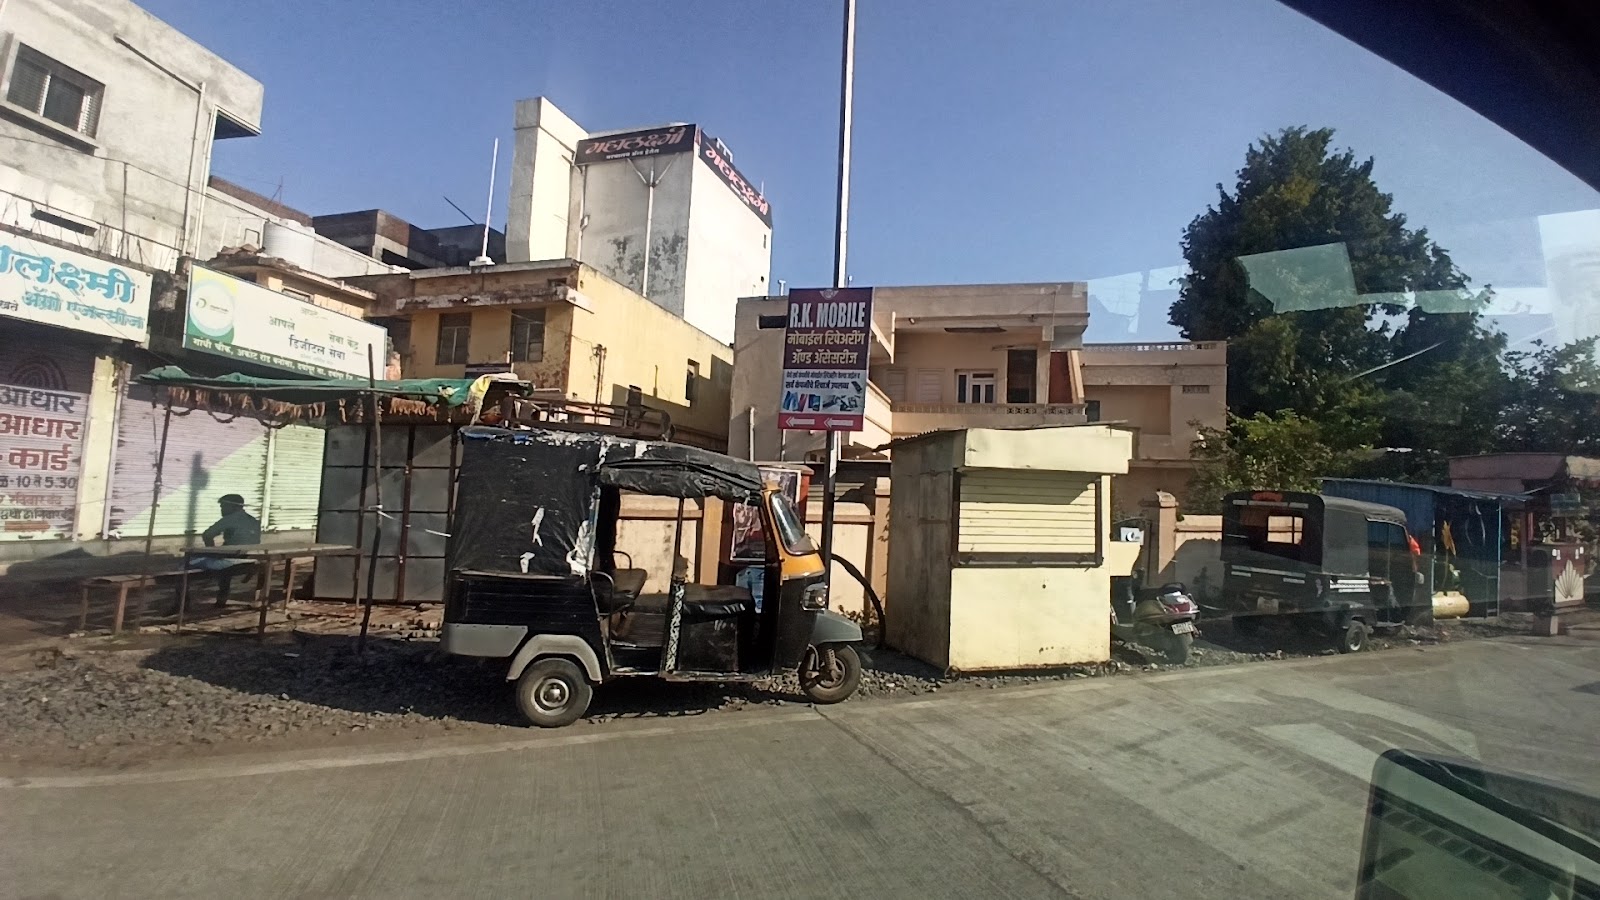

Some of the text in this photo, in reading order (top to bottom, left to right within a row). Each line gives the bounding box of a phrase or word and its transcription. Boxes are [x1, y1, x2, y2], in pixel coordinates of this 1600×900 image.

[585, 127, 686, 154] महालक्ष्मी
[789, 302, 866, 328] R.K. MOBILE
[787, 330, 823, 346] मोबाईल
[0, 385, 81, 414] आधार
[0, 414, 81, 440] आधार
[8, 444, 72, 471] कार्ड
